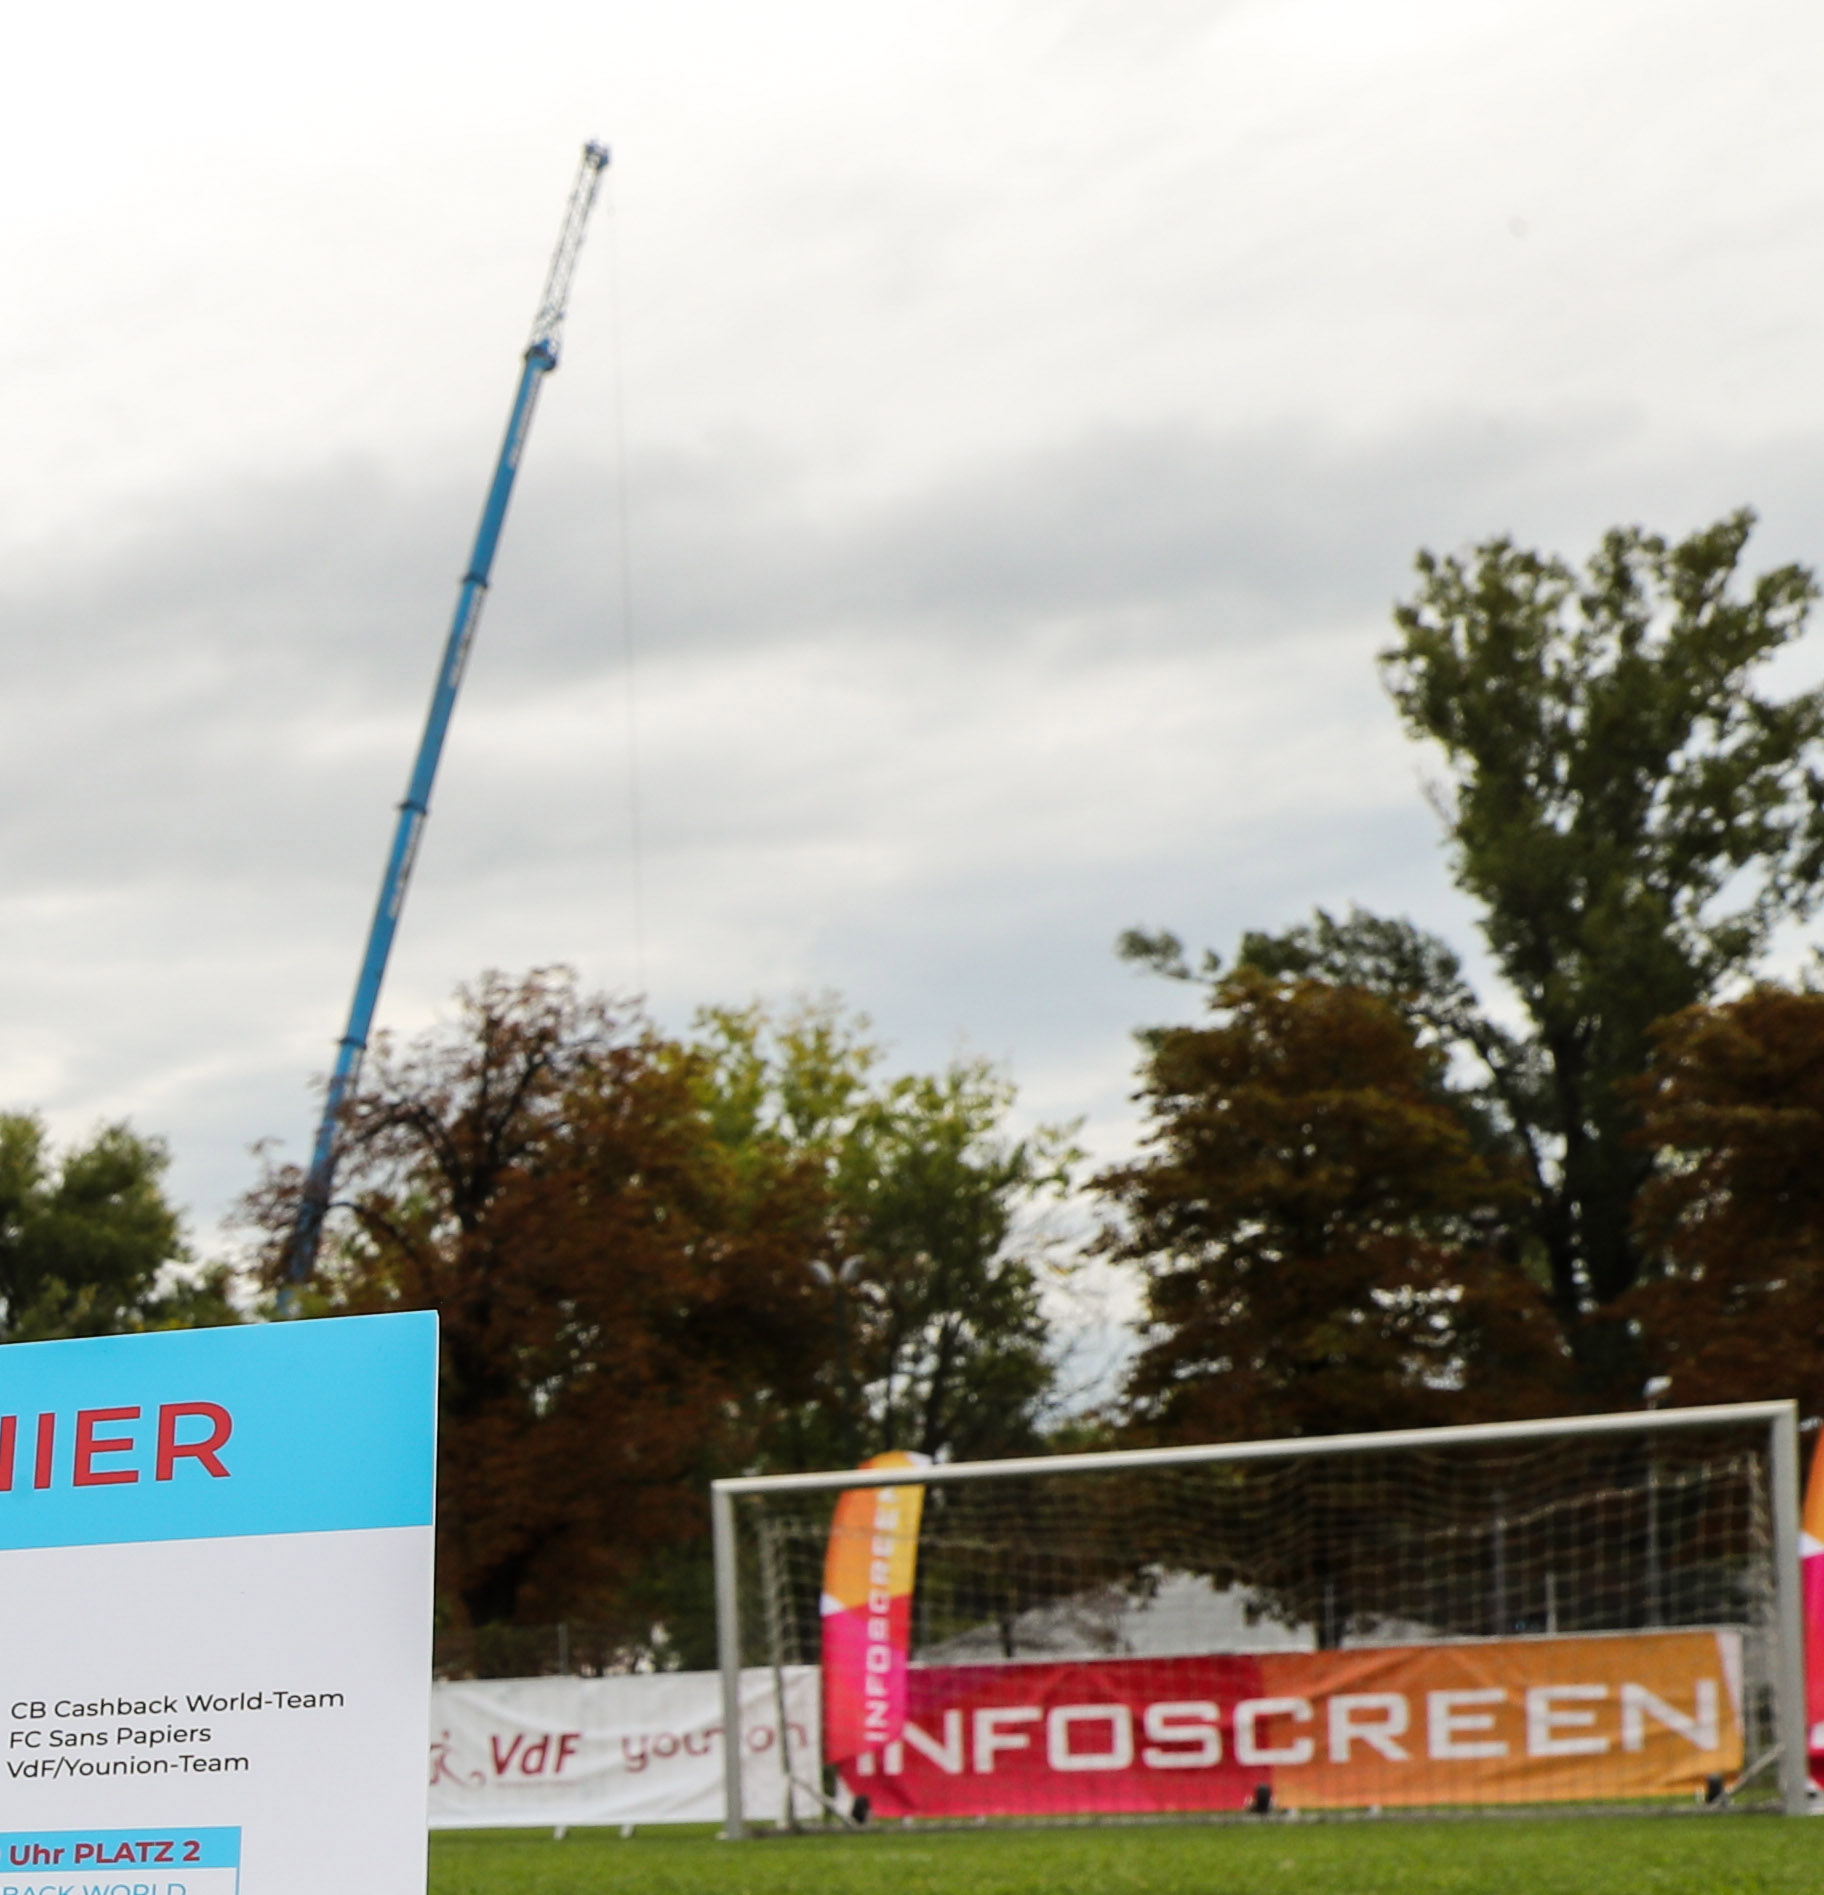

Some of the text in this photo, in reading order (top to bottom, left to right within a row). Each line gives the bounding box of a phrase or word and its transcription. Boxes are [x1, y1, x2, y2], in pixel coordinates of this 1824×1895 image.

[12, 1692, 343, 1719] CB Cashback World-Team
[11, 1725, 211, 1748] FC Sans Papiers
[856, 1679, 1720, 1775] NFOSCREEN
[7, 1755, 248, 1778] VdF/Younion-Team
[491, 1732, 581, 1776] VdF
[10, 1844, 65, 1865] Uhr
[75, 1841, 174, 1863] PLATZ
[183, 1841, 200, 1861] 2
